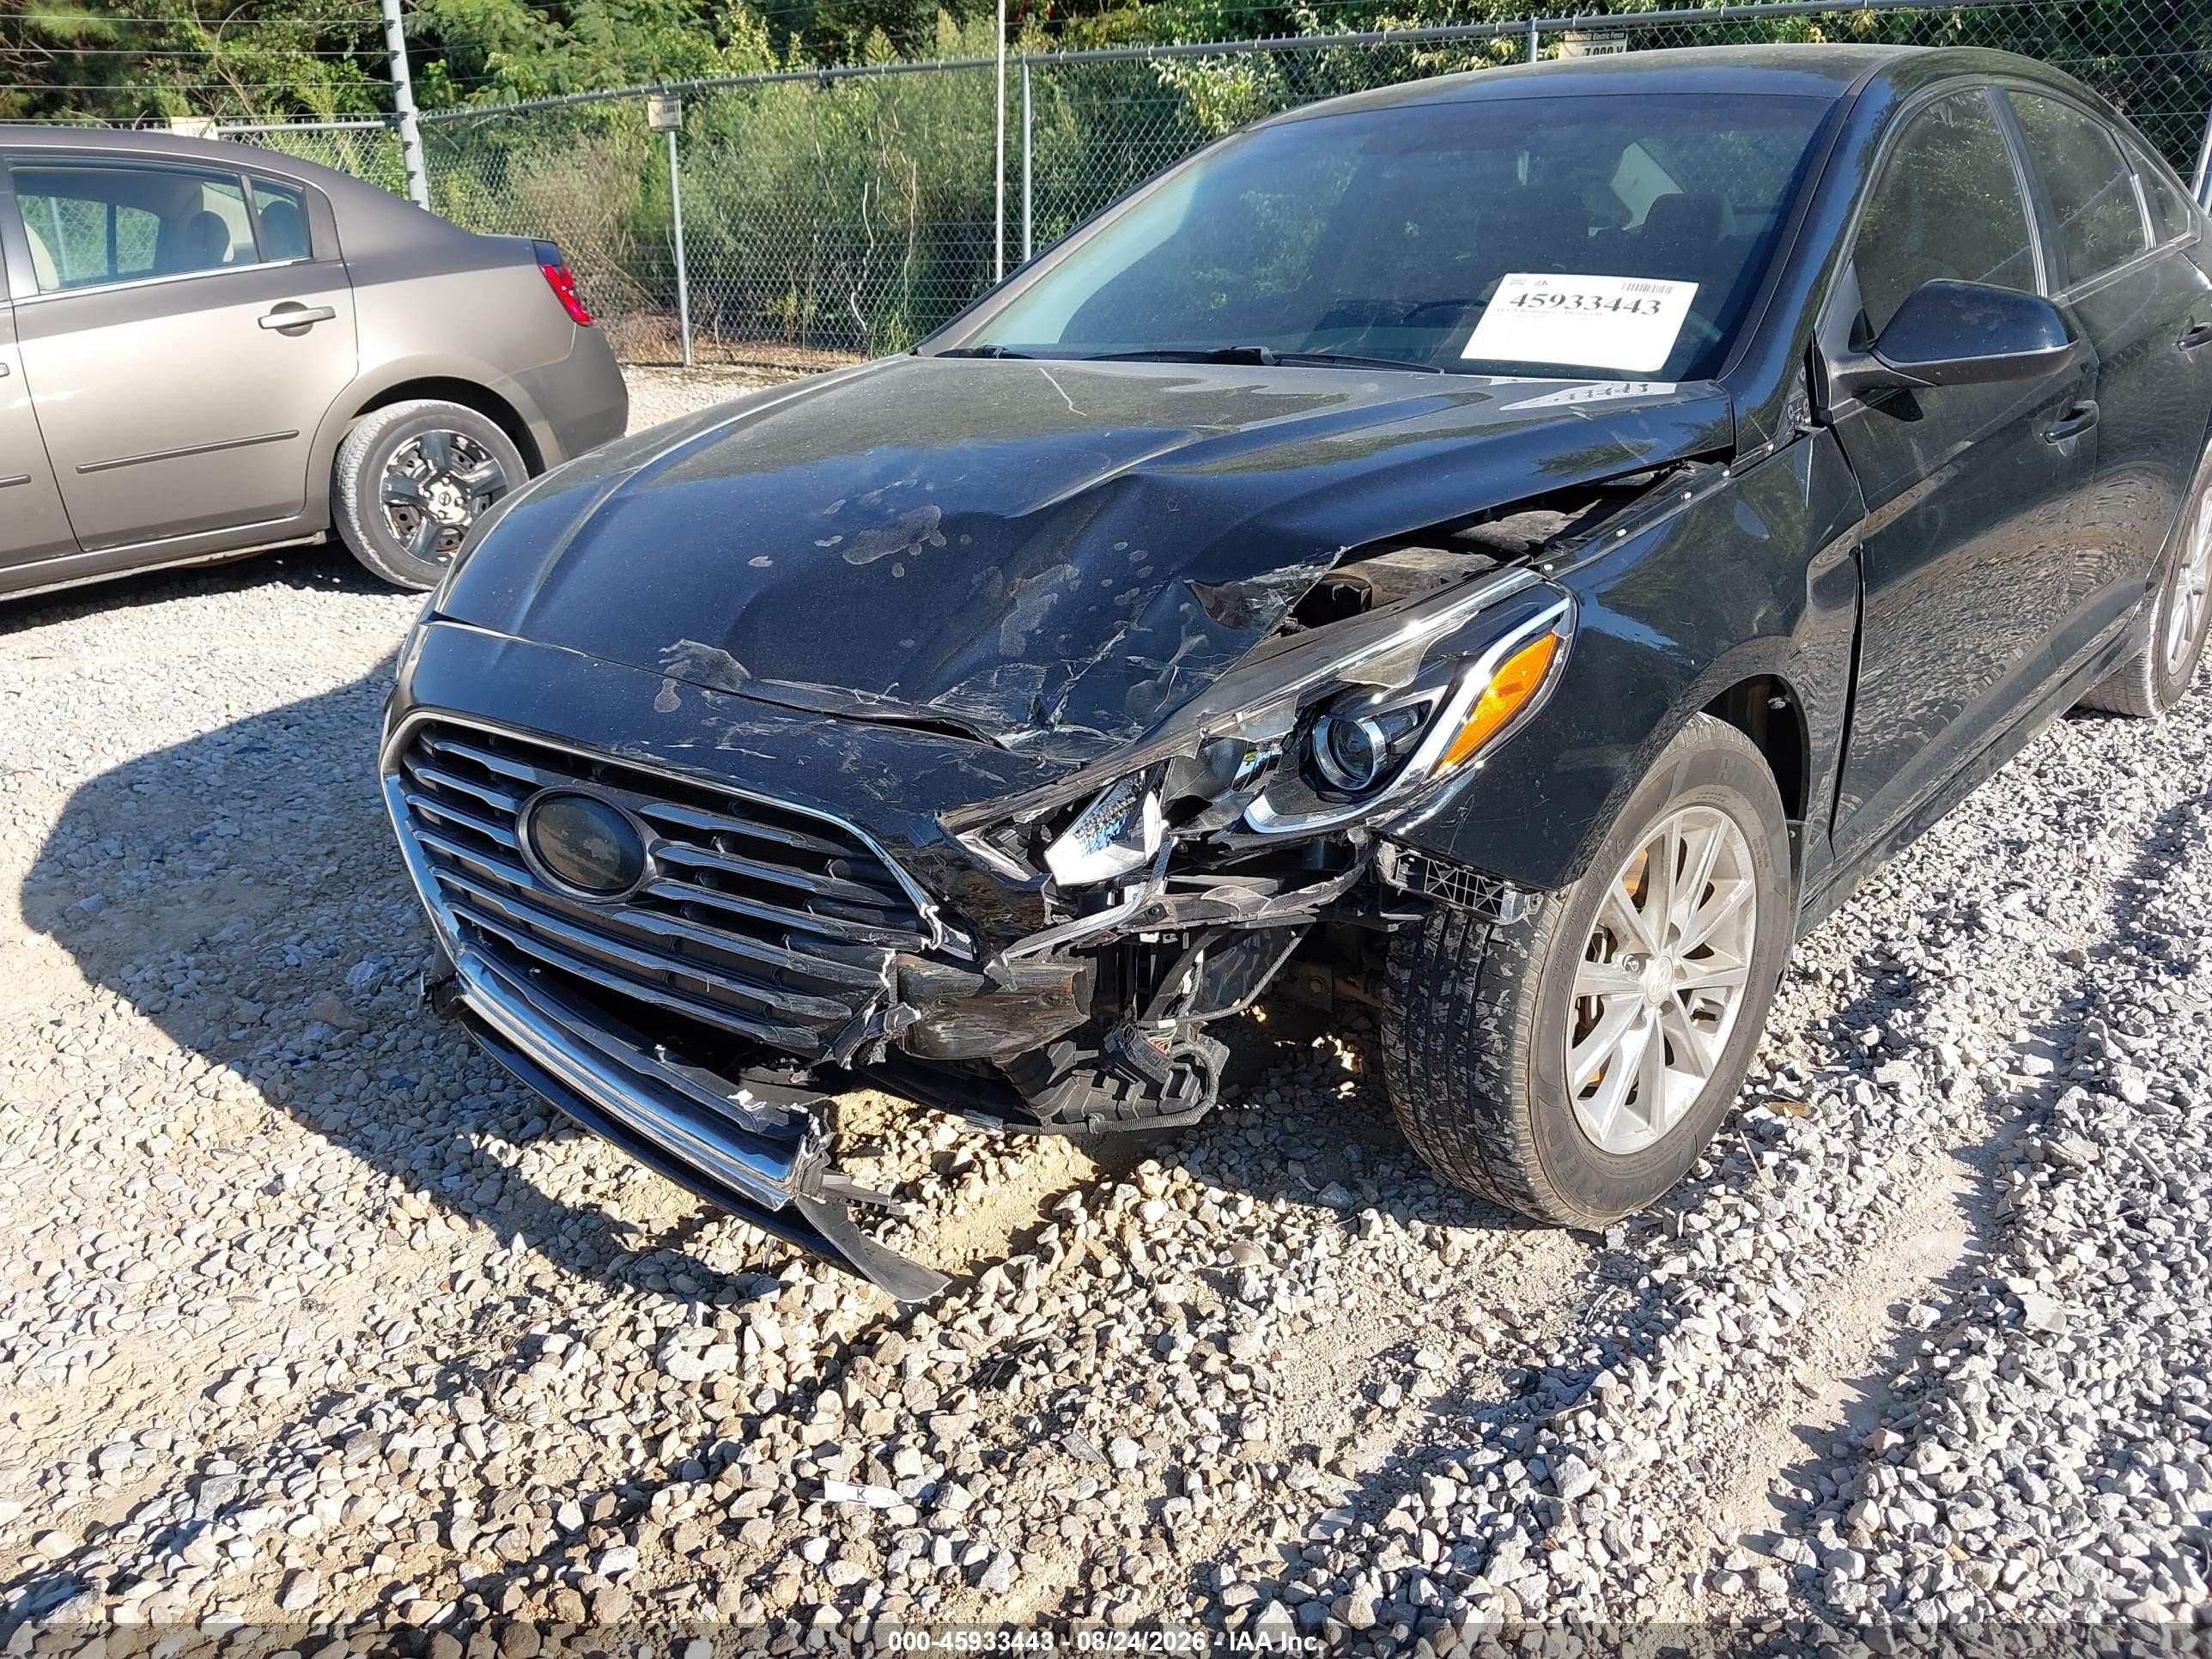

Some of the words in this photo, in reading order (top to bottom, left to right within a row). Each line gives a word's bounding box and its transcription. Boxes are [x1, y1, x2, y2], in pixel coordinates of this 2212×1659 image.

[1584, 46, 1613, 56] 7000
[1510, 292, 1661, 315] 45933443
[857, 1488, 866, 1500] K
